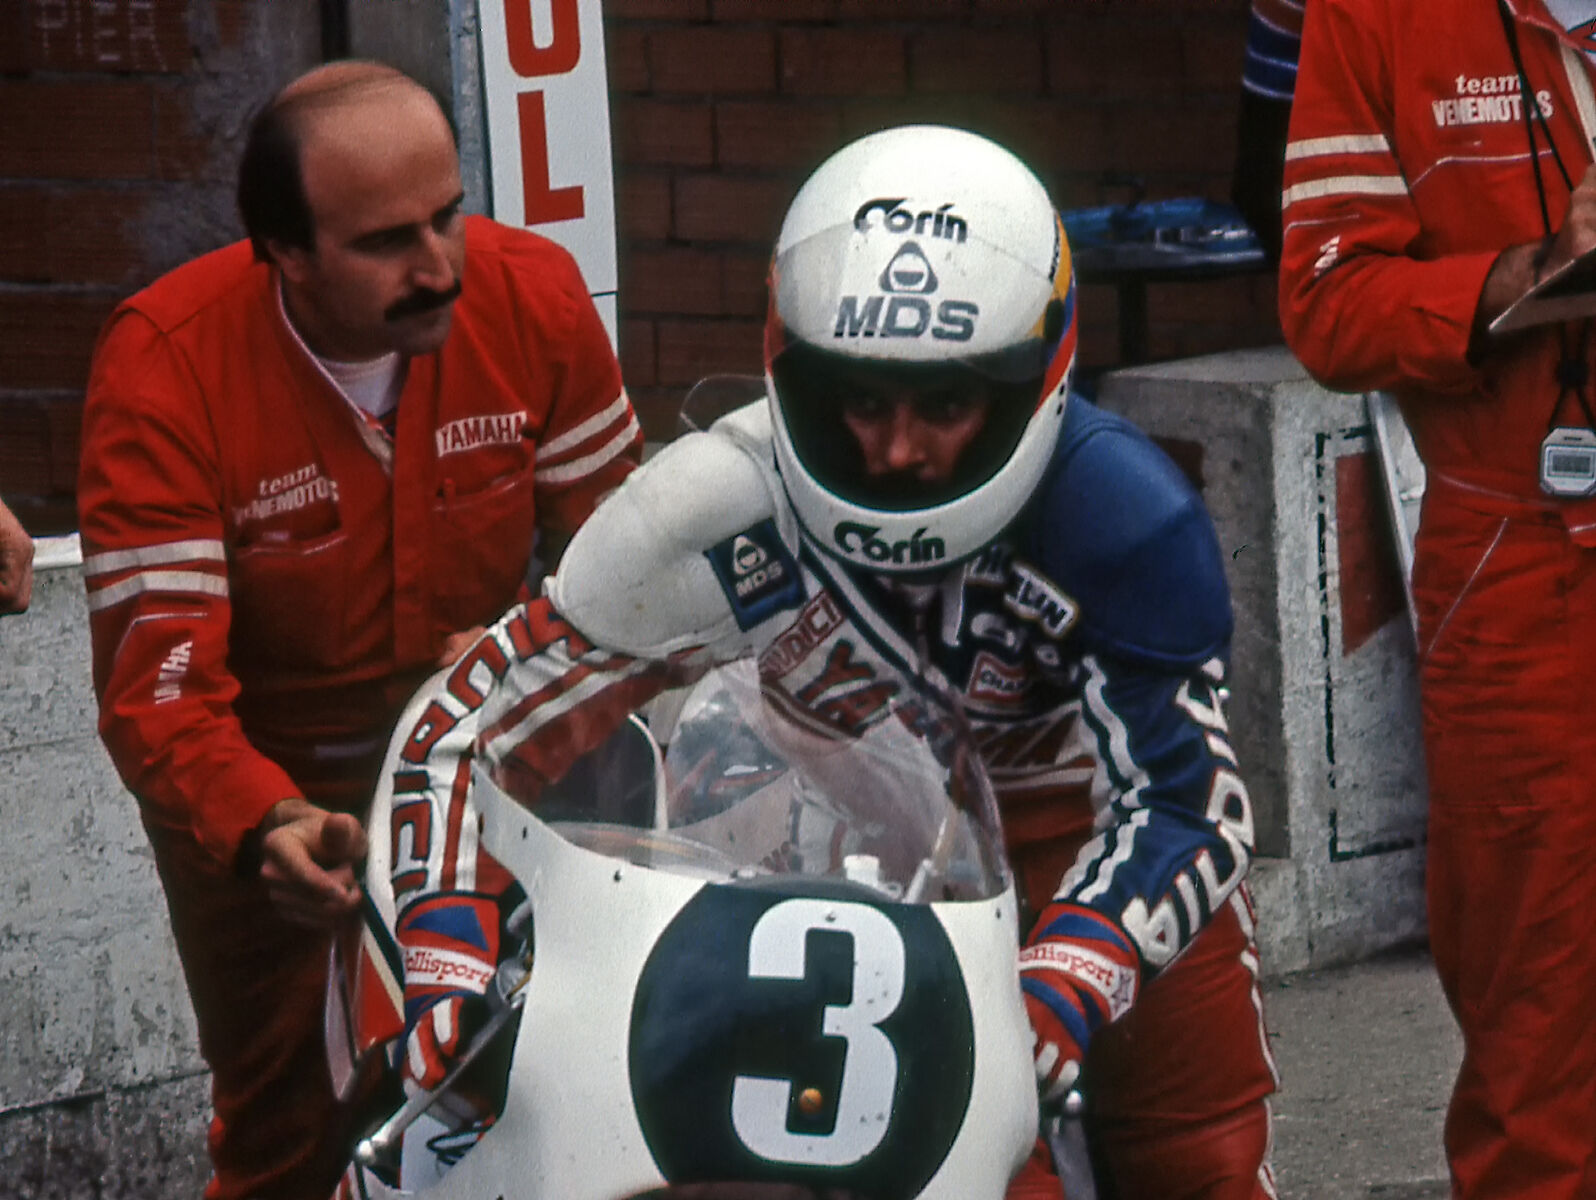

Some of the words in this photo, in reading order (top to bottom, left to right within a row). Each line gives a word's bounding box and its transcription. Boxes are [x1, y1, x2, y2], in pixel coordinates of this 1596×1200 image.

[1456, 73, 1523, 95] team
[1432, 91, 1554, 127] VENEMOTS
[833, 296, 980, 342] MDS
[258, 464, 317, 497] team
[734, 561, 783, 598] MDS
[731, 898, 906, 1166] 3
